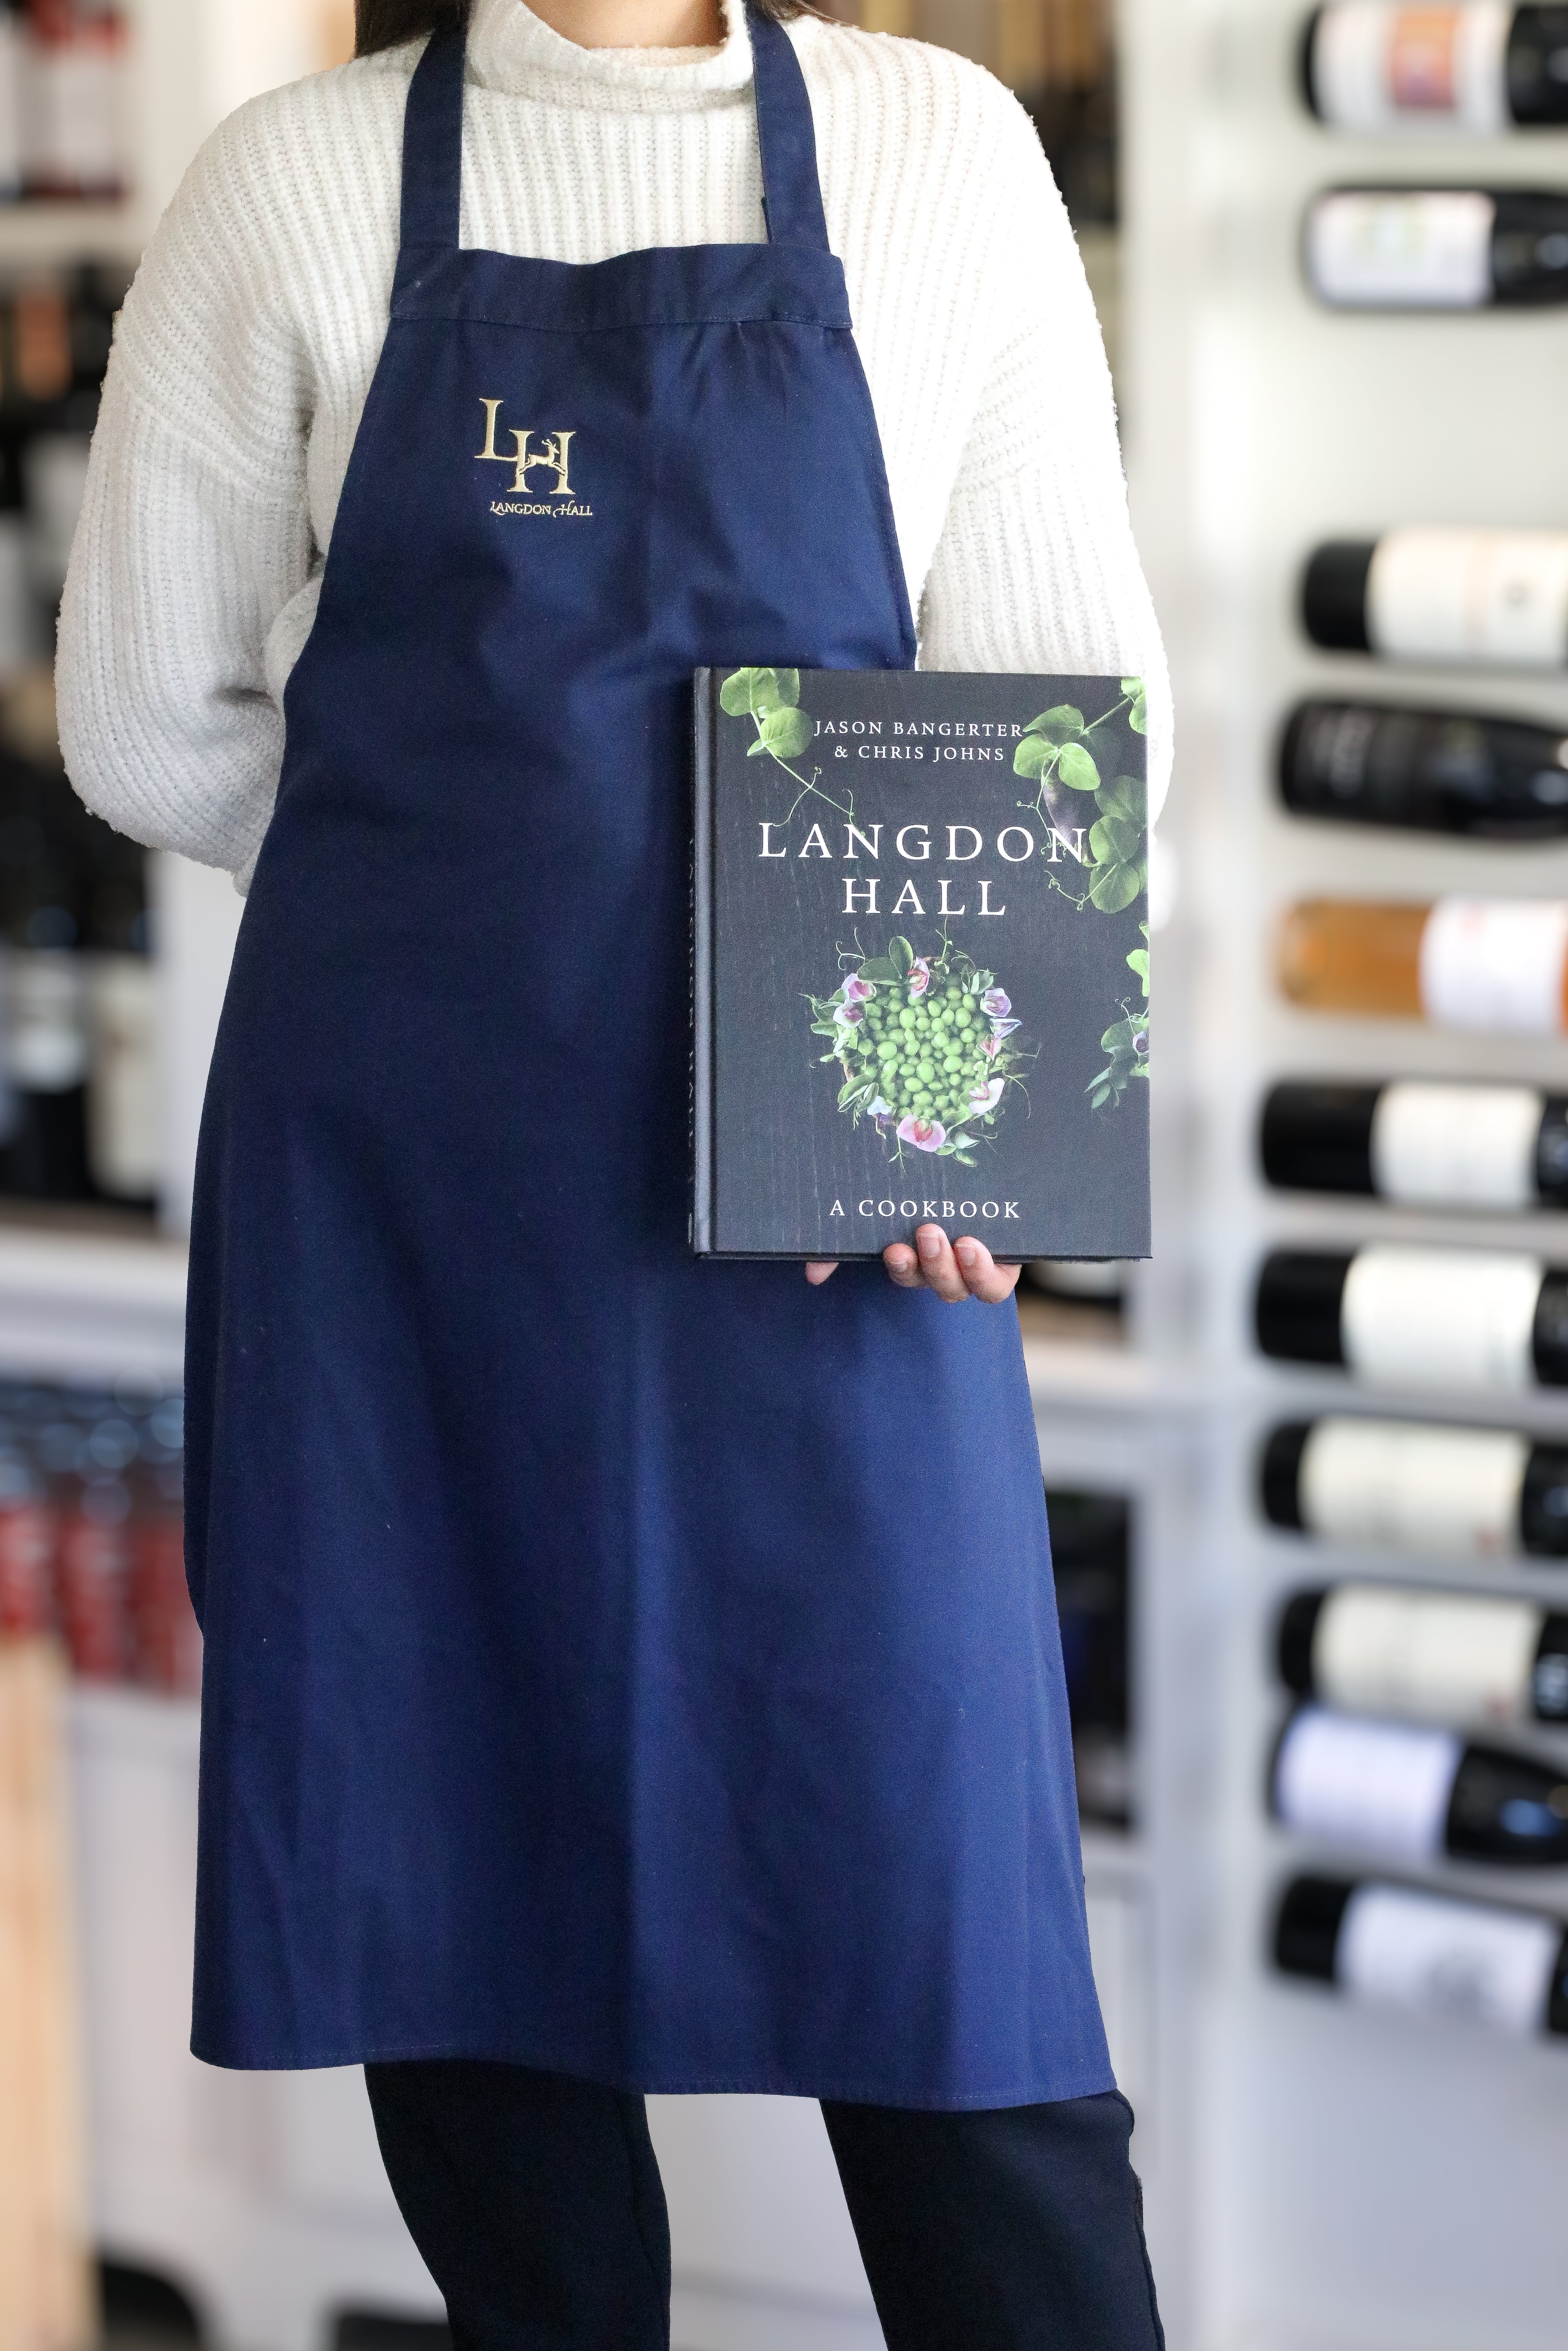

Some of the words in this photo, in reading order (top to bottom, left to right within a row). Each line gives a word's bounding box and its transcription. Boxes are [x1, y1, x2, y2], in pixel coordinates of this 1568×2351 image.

[490, 501, 551, 516] LANGDON
[552, 500, 593, 518] HALL
[813, 720, 883, 737] JASON
[893, 721, 1023, 738] BANGERTER
[834, 745, 849, 758] &
[858, 745, 924, 760] CHRIS
[932, 746, 1004, 763] JOHNS
[758, 821, 1088, 863] LANGDON
[841, 878, 1007, 917] HALL
[829, 1199, 845, 1217] A
[858, 1198, 1020, 1219] COOKBOOK
